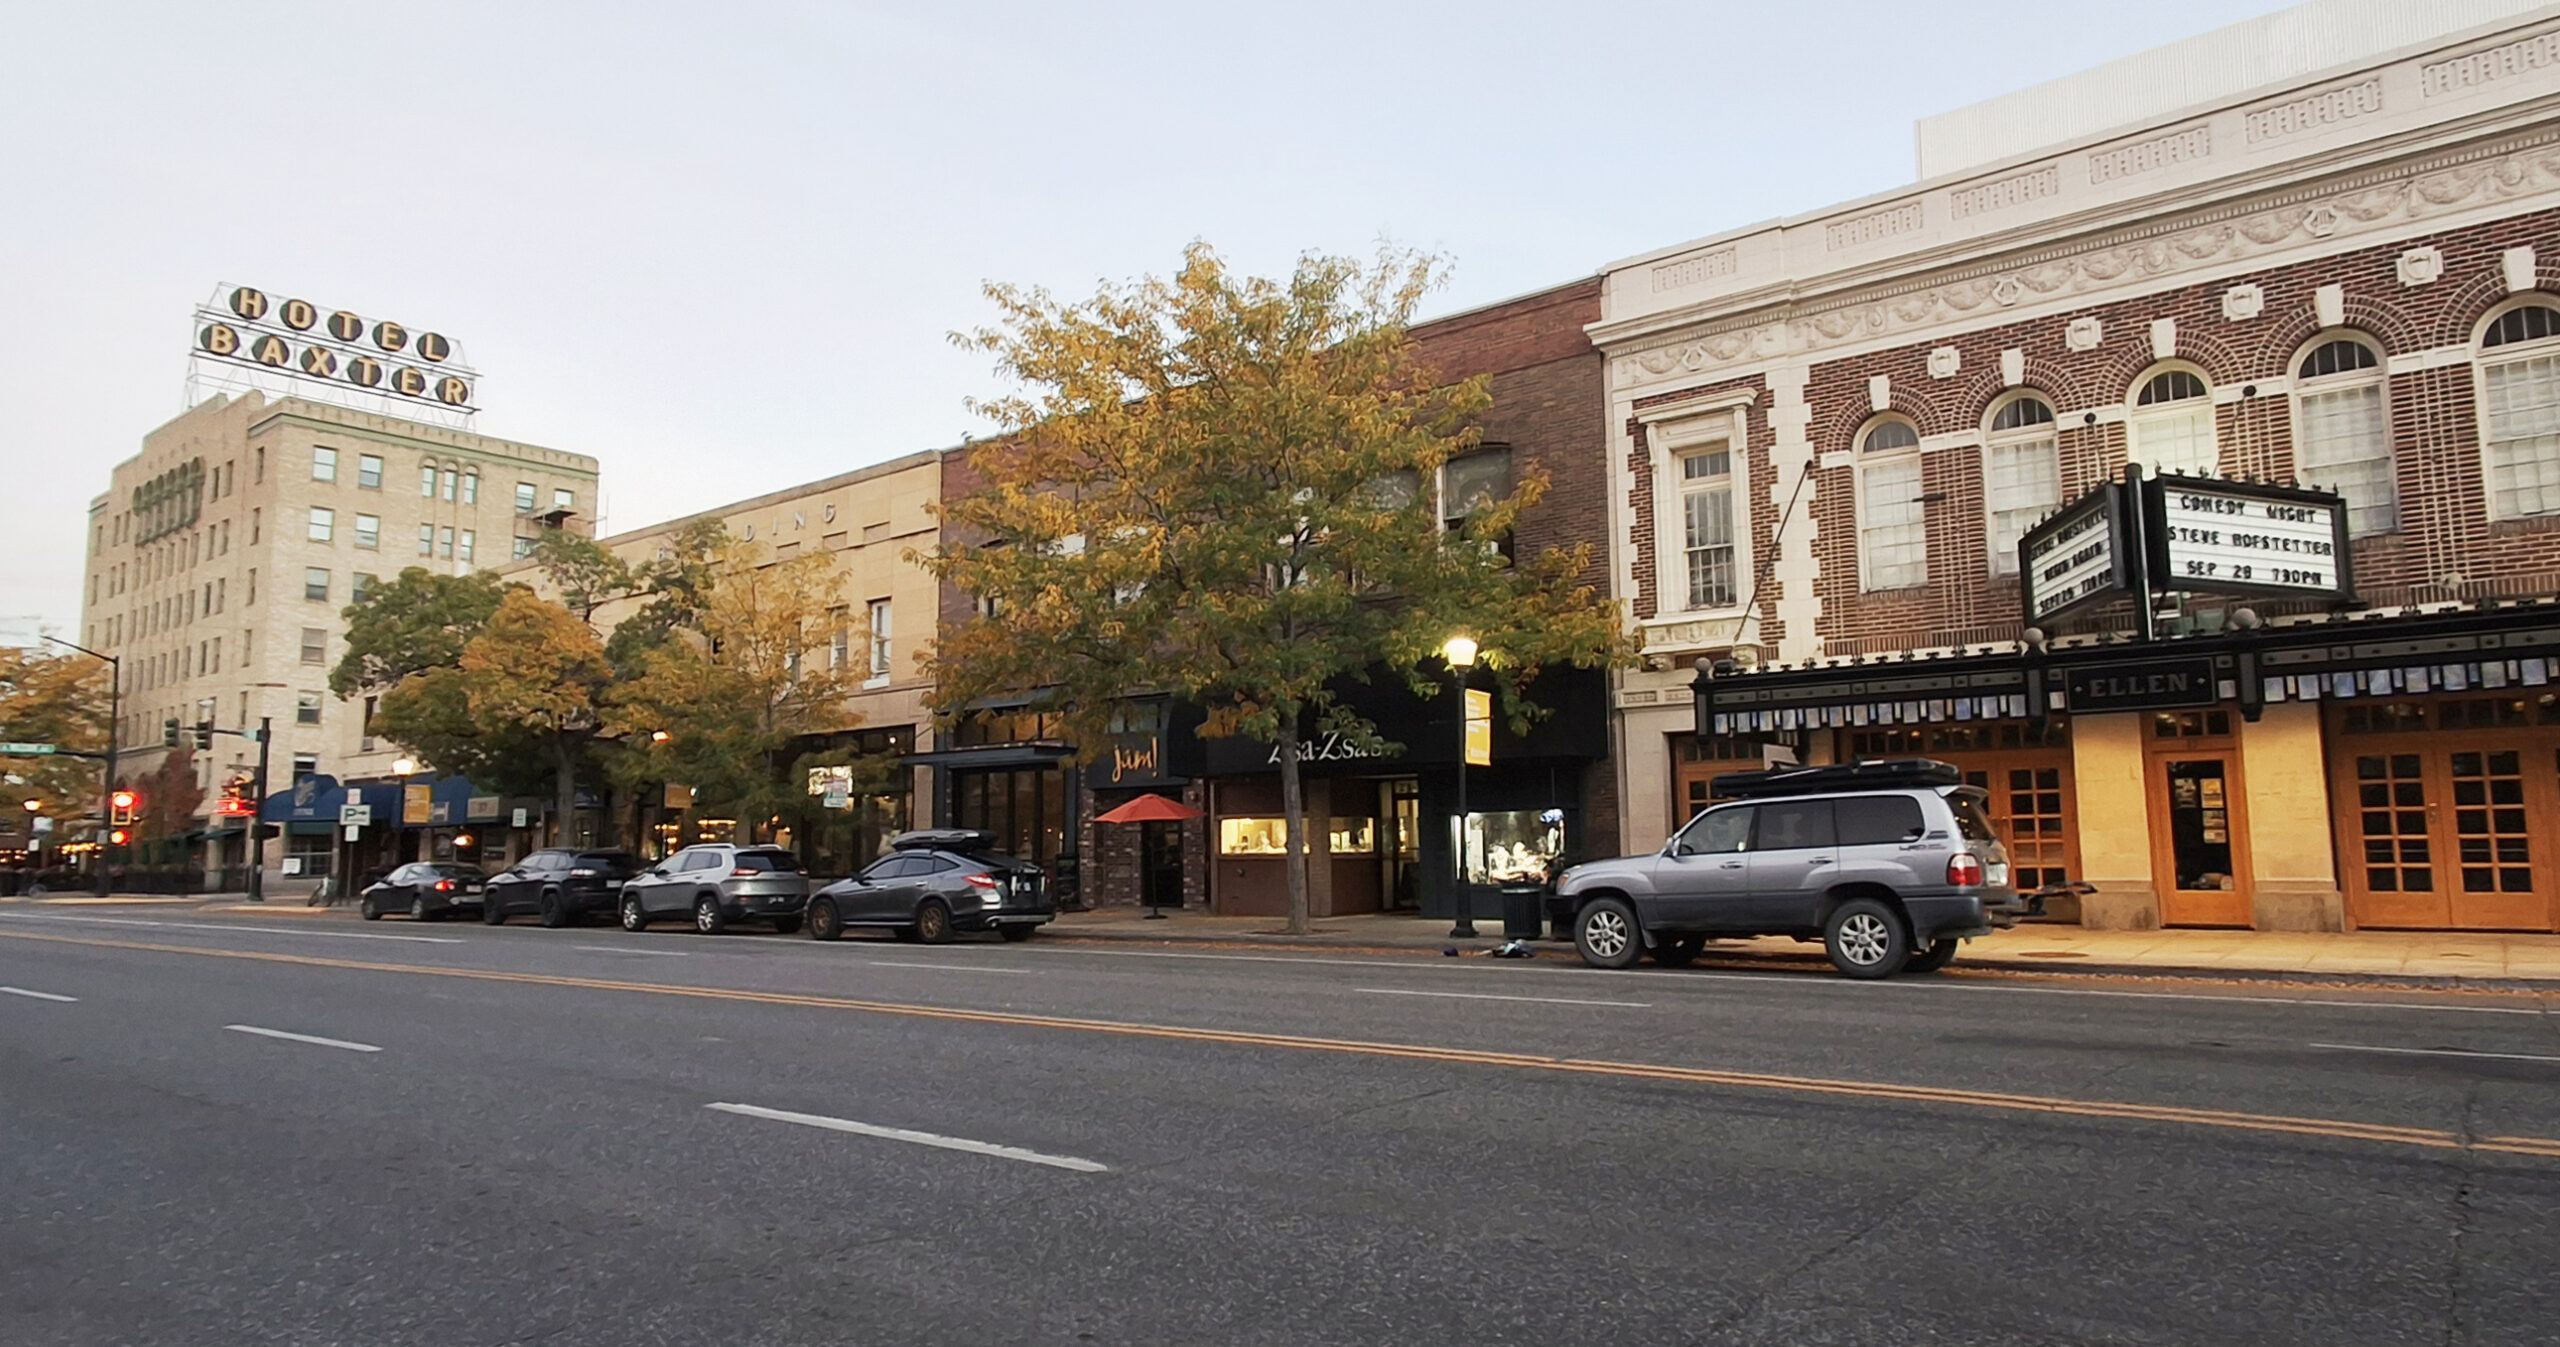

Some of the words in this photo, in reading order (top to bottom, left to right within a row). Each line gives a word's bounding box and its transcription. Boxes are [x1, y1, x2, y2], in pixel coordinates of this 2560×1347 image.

[238, 287, 446, 361] HOTEL
[208, 323, 466, 406] BAXTER
[2180, 494, 2246, 516] COMEDY
[2168, 526, 2220, 545] STEVE
[2187, 560, 2218, 576] SEP
[2089, 673, 2188, 697] ELLEN
